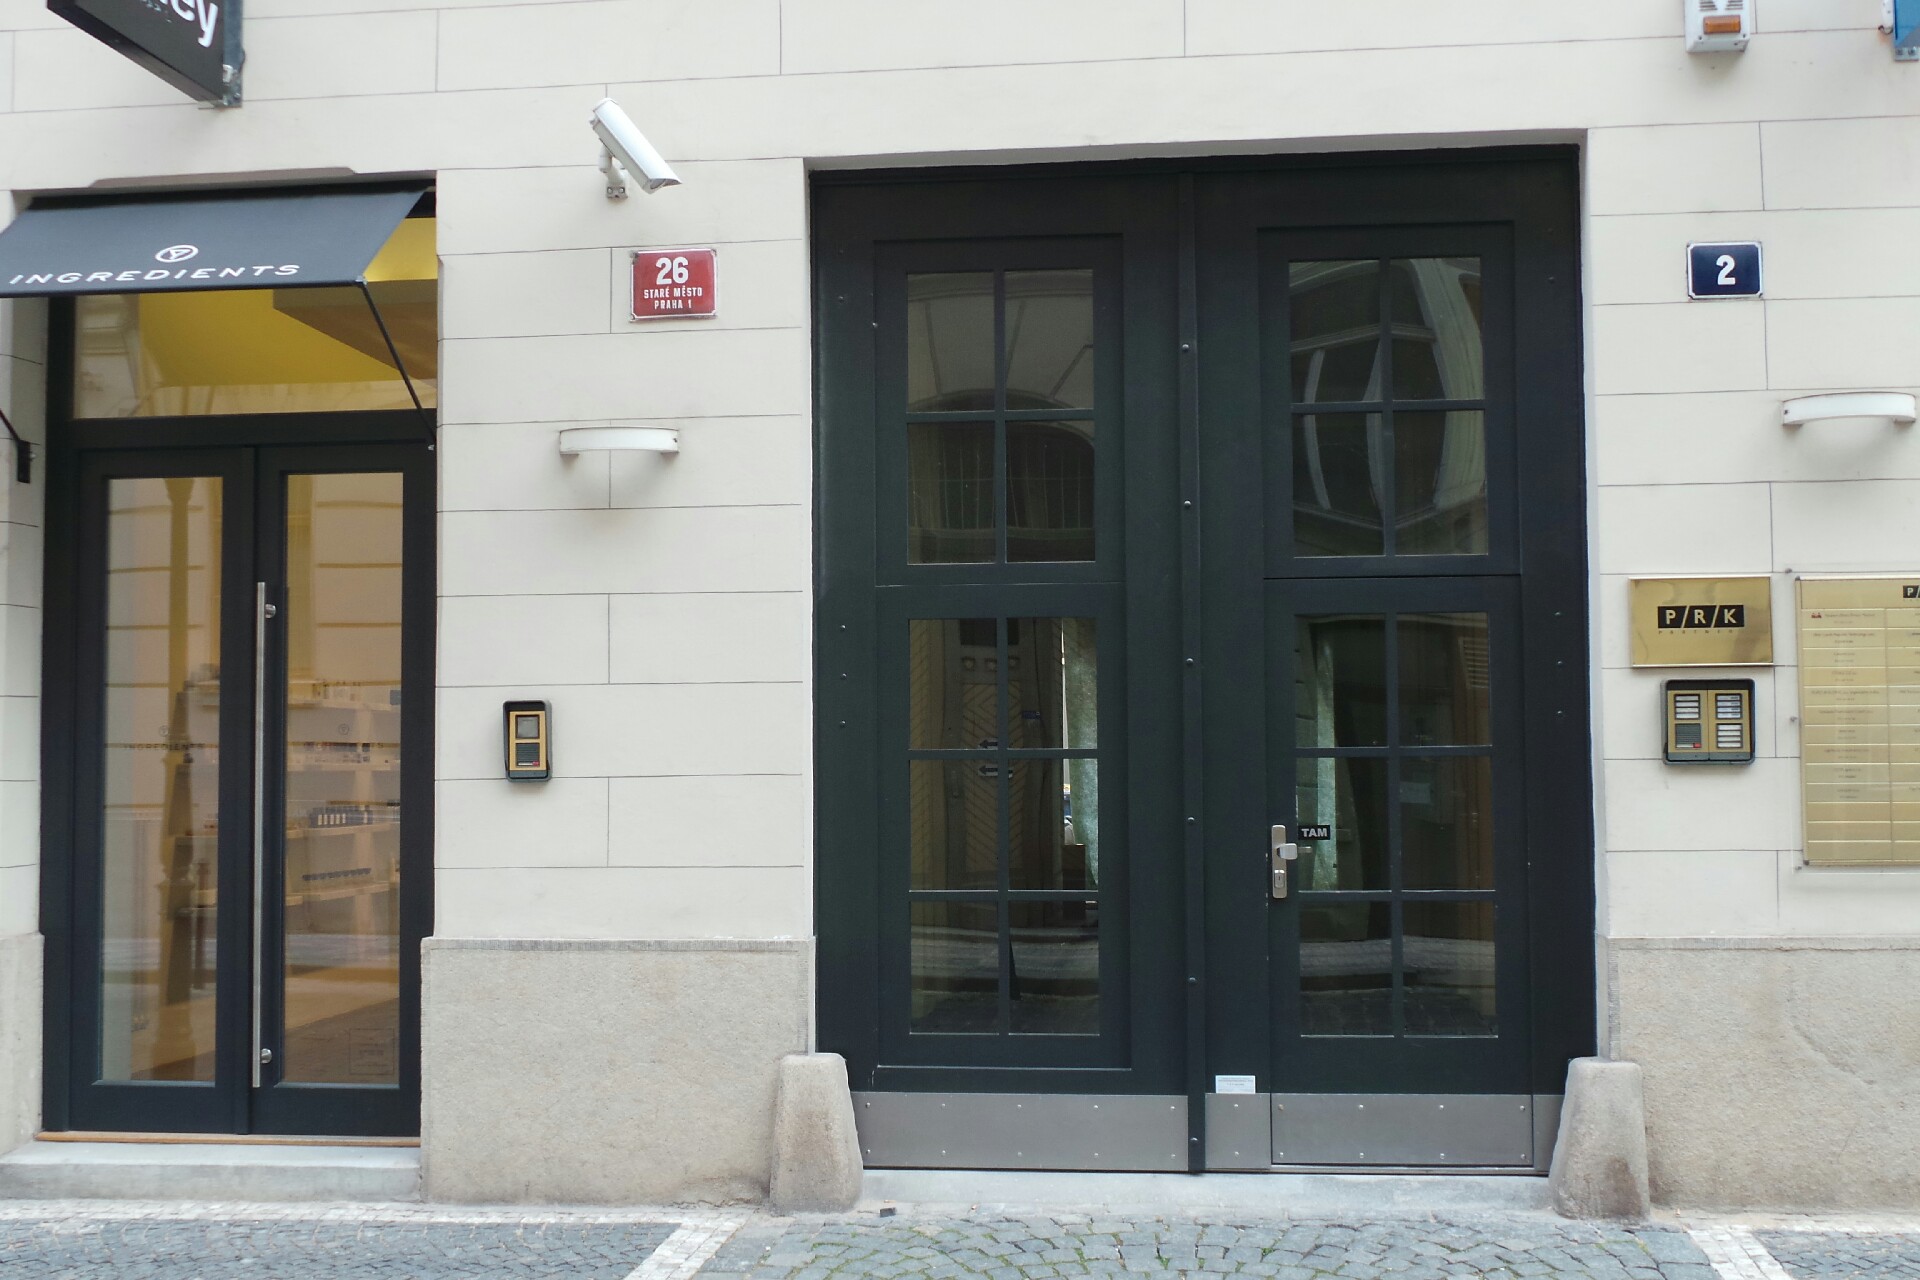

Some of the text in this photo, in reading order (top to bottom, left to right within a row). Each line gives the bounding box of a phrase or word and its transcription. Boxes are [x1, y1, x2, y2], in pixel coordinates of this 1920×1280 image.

[160, 0, 219, 48] ey
[9, 264, 301, 285] INGREDIENTS
[655, 256, 689, 285] 26
[1716, 254, 1736, 286] 2
[643, 285, 703, 299] STARÉ MĚSTO
[654, 299, 692, 310] PRAHA 1
[1301, 828, 1328, 838] TAM
